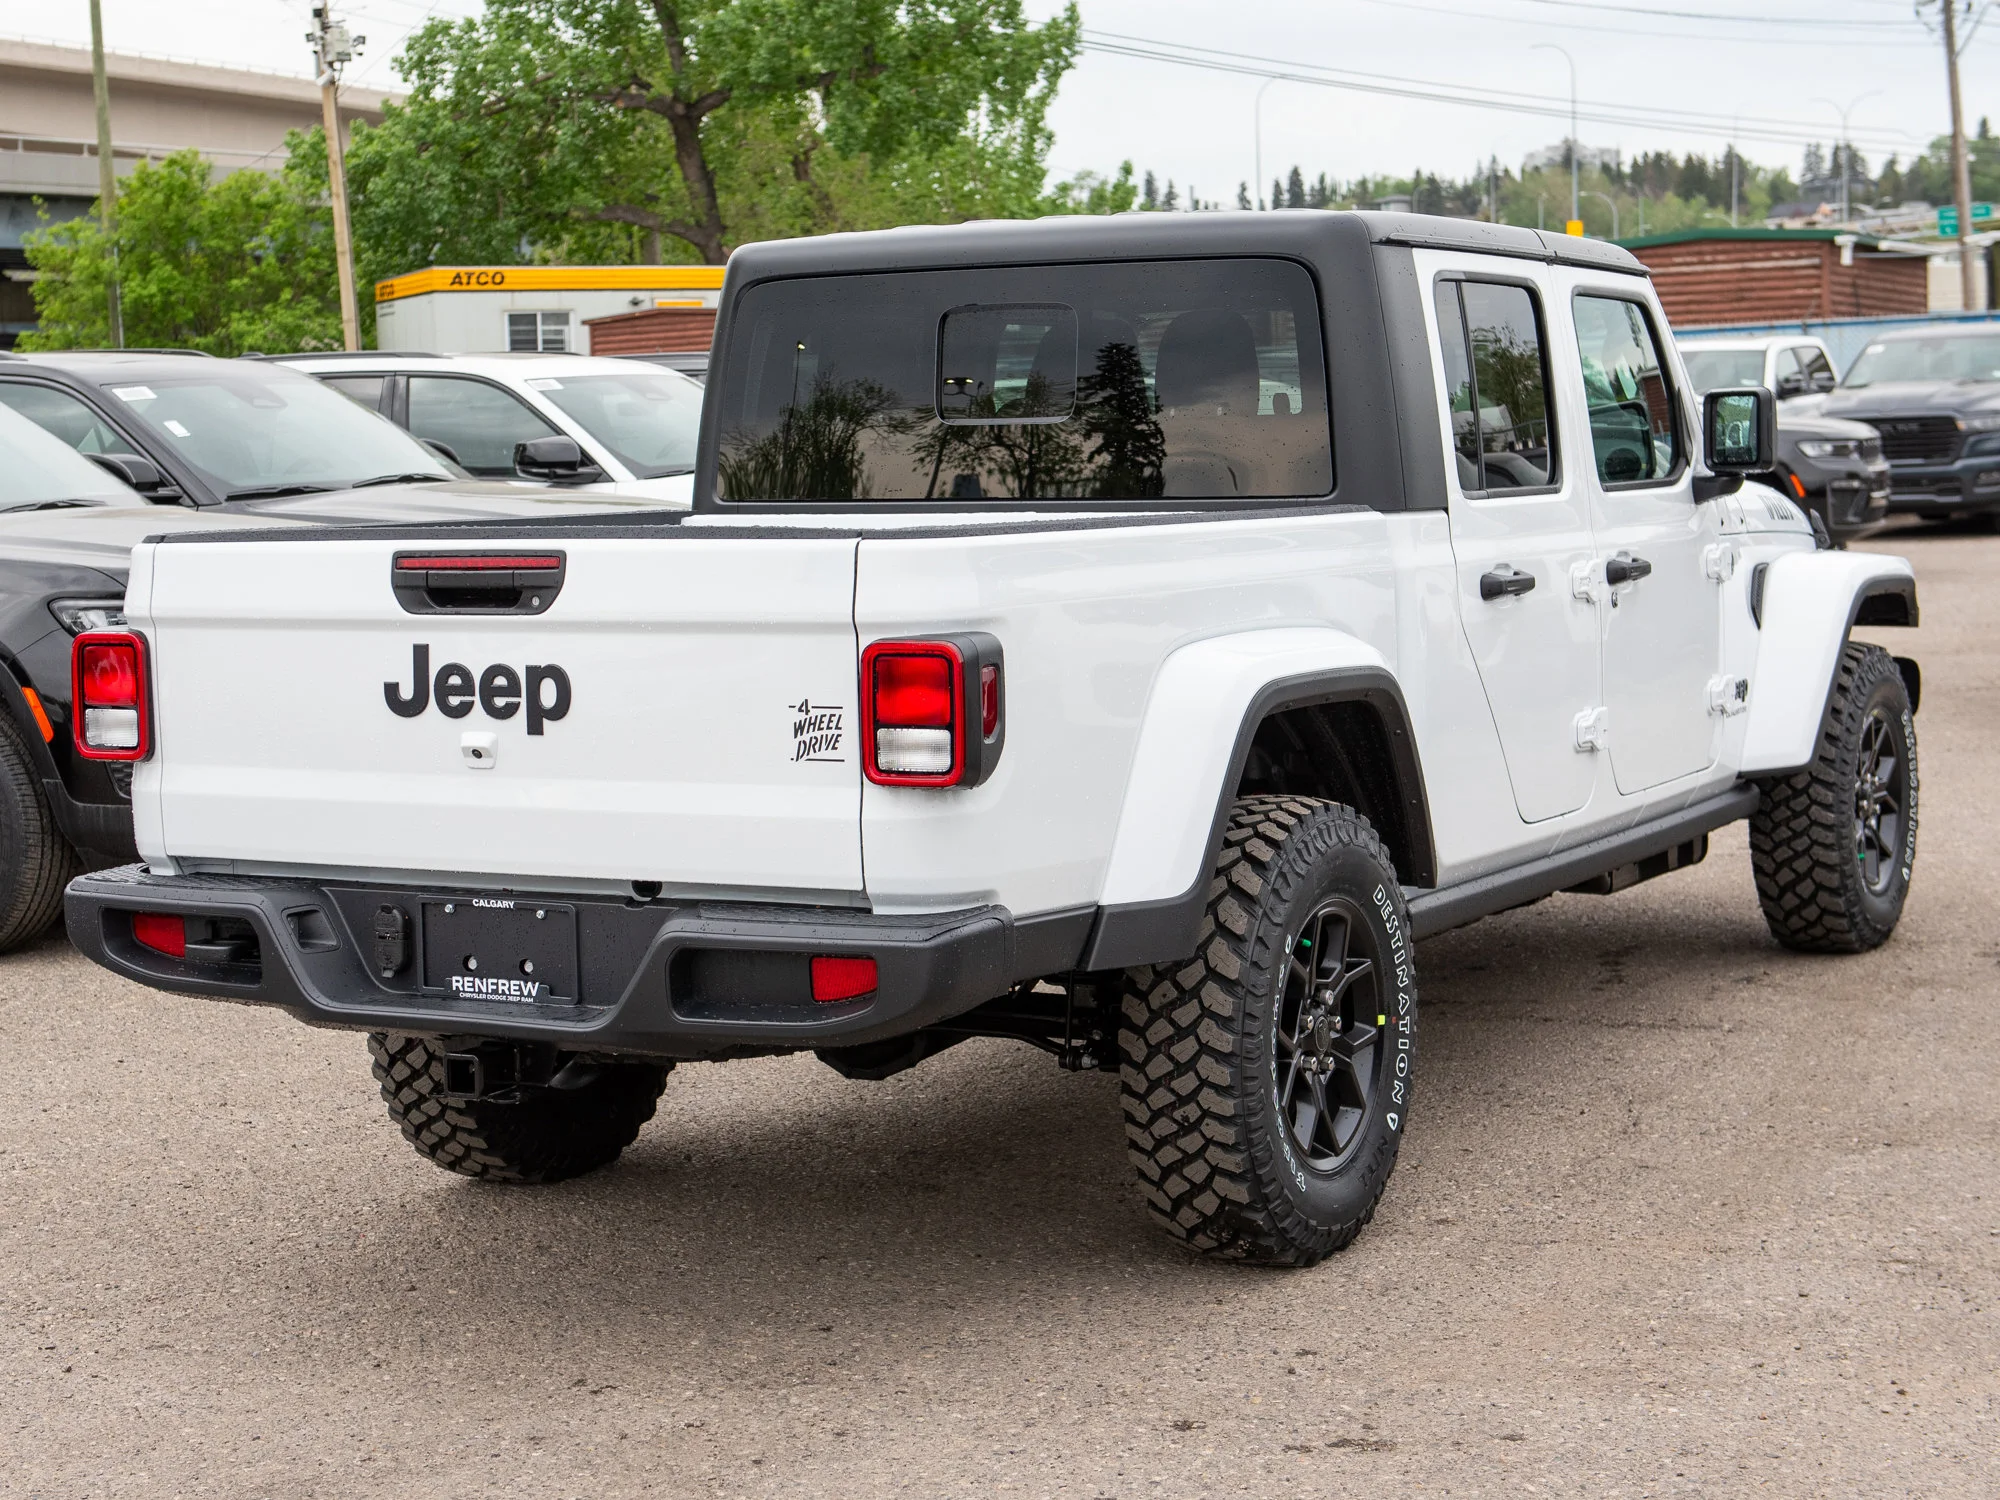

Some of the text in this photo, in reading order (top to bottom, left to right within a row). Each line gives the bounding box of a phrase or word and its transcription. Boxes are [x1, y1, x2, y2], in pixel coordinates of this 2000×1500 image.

[450, 271, 505, 286] ATCO
[384, 643, 572, 735] Jeep
[798, 699, 810, 715] 4
[794, 714, 843, 739] WHEEL
[796, 734, 842, 762] DRIVE
[472, 899, 515, 908] CALGARY
[452, 976, 540, 996] RENFREW
[459, 992, 487, 1000] CHRYSLER
[1373, 884, 1410, 1104] DESTINATION
